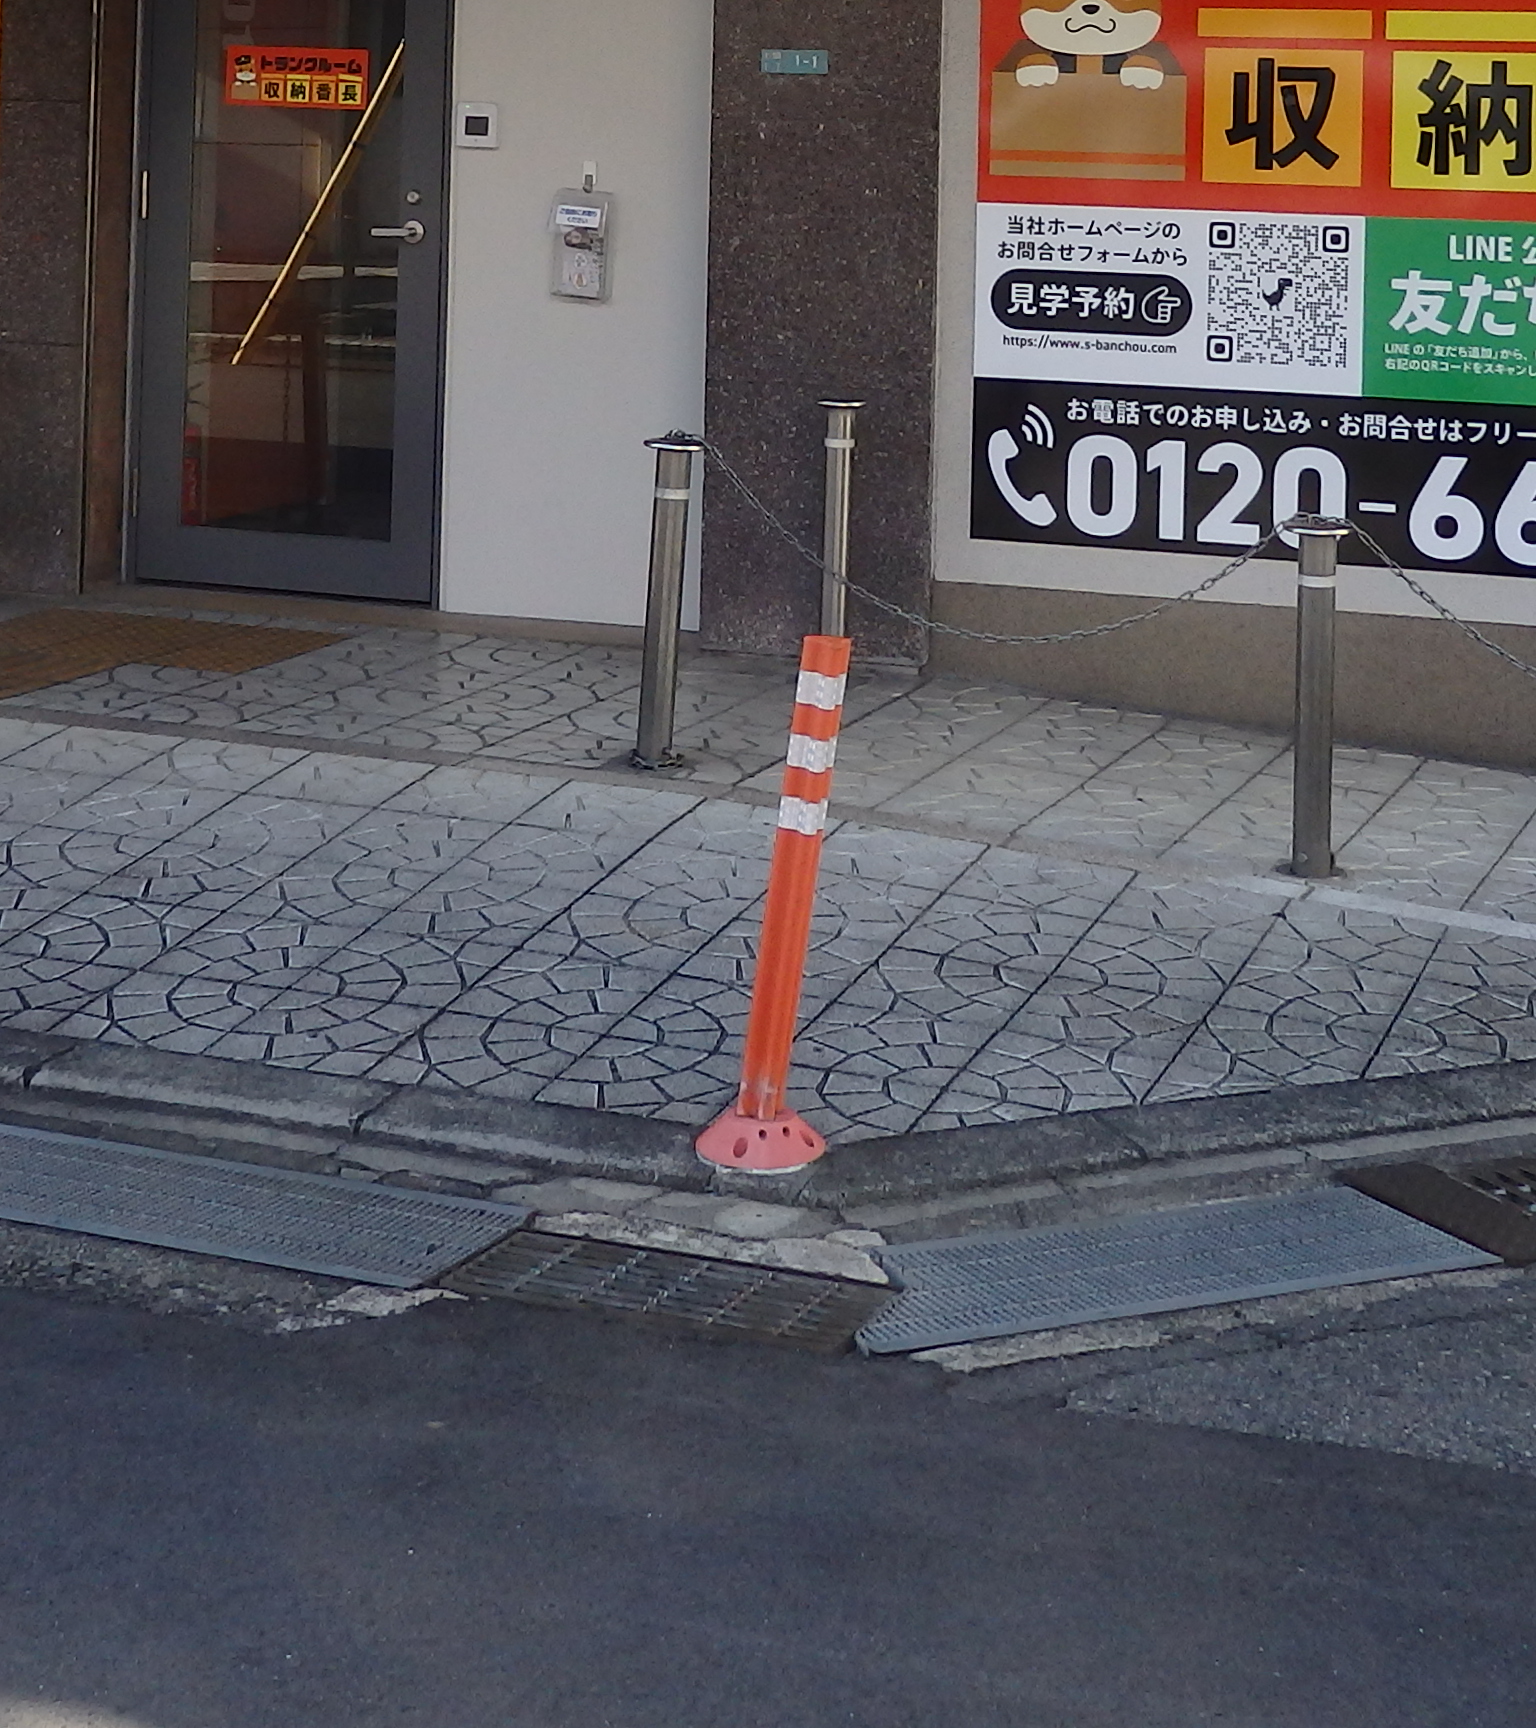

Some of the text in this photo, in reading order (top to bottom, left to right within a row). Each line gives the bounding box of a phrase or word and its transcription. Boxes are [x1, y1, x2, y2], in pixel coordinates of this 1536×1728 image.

[260, 54, 363, 74] トランクルーム
[1006, 215, 1181, 240] 当社ホームページの
[996, 240, 1189, 267] お問合せフォームから
[1448, 234, 1513, 262] LINE
[1005, 282, 1136, 320] 見学予約
[1002, 333, 1177, 354] https://www.s-banchou.com
